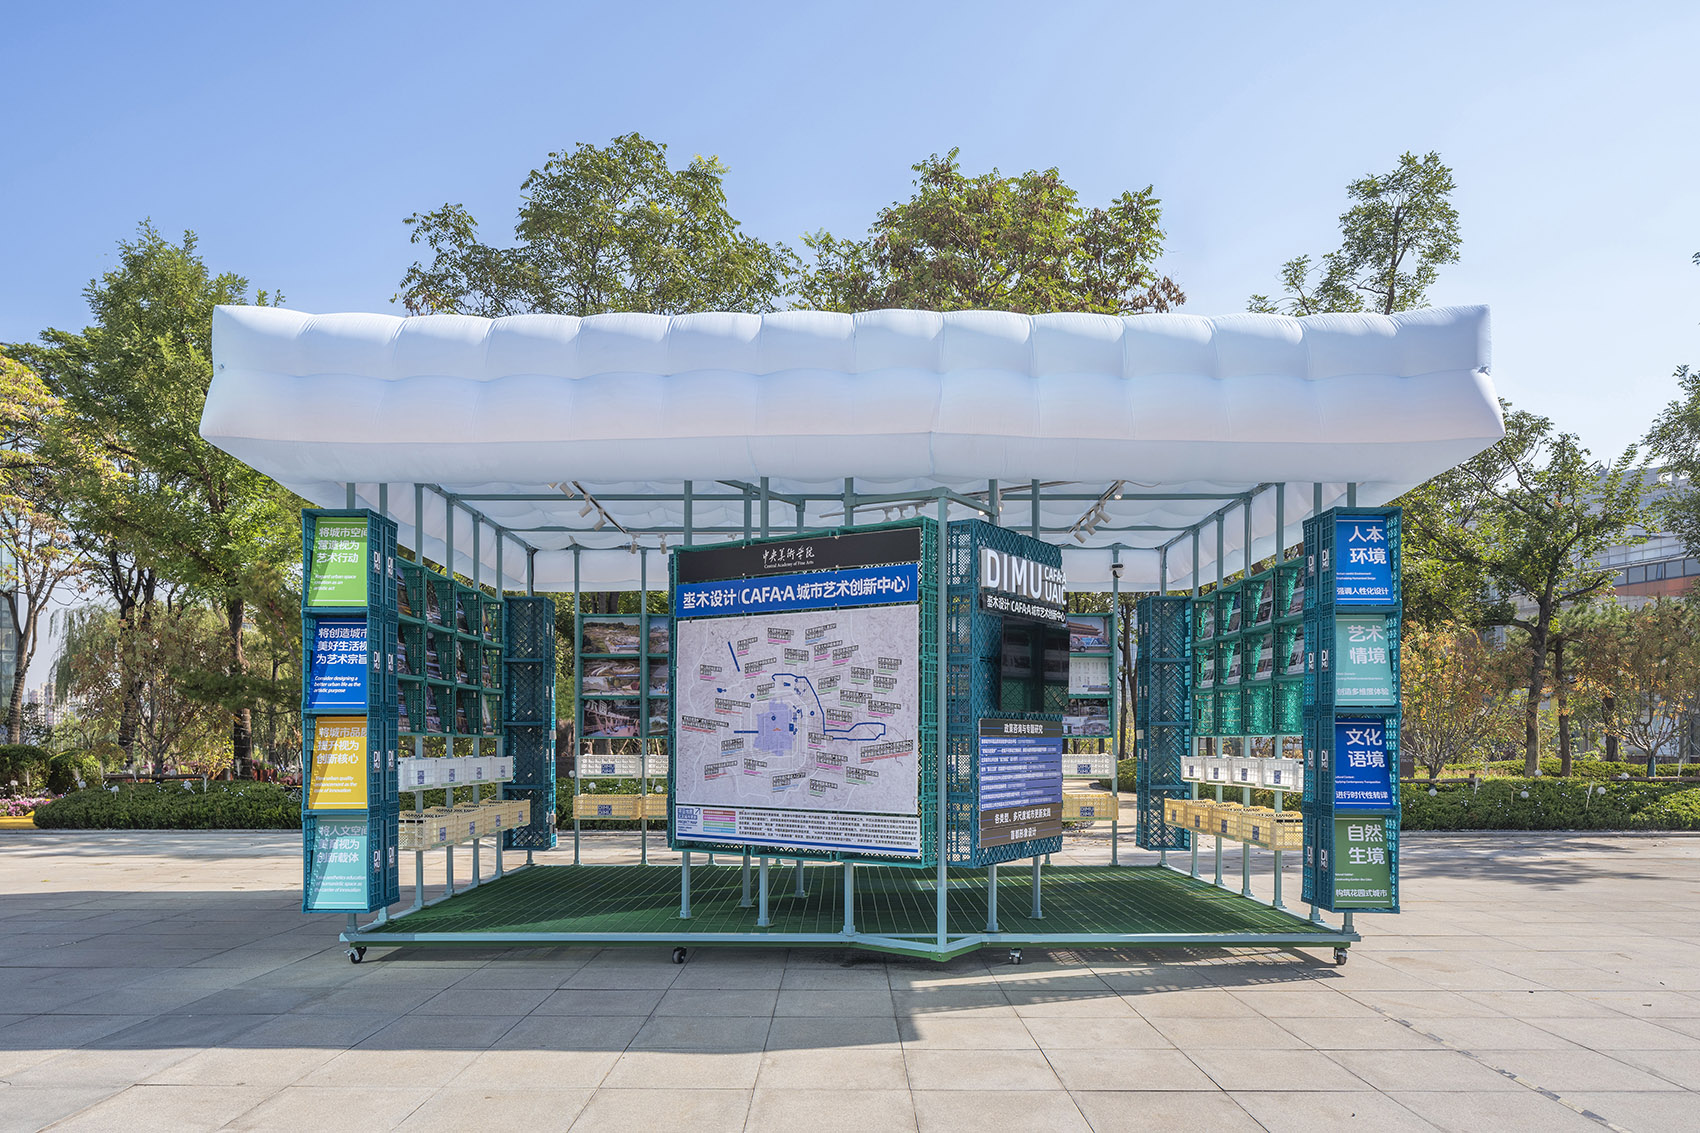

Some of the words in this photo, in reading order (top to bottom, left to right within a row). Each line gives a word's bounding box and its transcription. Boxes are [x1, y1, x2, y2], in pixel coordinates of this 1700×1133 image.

[1349, 525, 1384, 543] 人本
[316, 553, 358, 563] 艺术行动
[1349, 547, 1387, 565] 环境
[982, 548, 1042, 599] DIMU
[1347, 625, 1384, 642] 艺术
[316, 654, 367, 665] 为艺术宗旨
[1349, 646, 1386, 664] 情境
[317, 740, 359, 751] 提升视为
[1345, 728, 1383, 746] 文化
[317, 753, 359, 764] 创新核心
[1347, 750, 1386, 768] 语境
[1347, 824, 1383, 842] 自然
[1348, 846, 1385, 865] 生境
